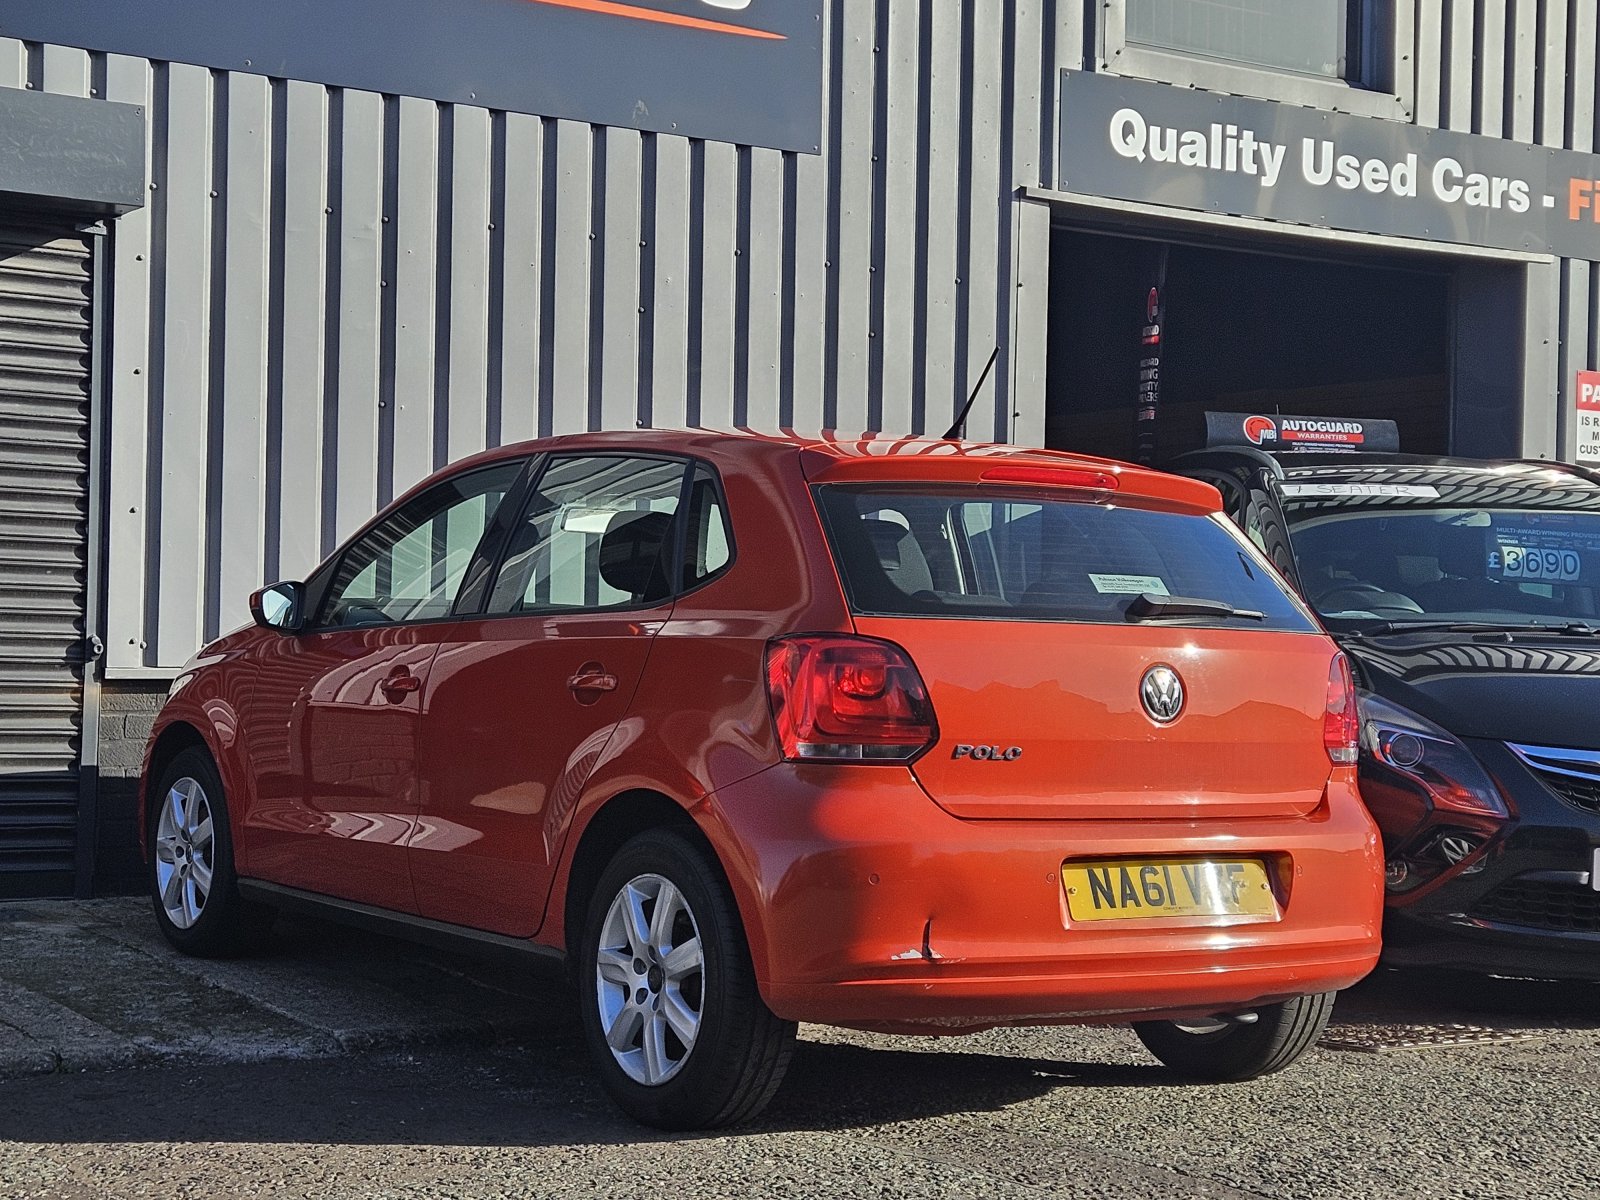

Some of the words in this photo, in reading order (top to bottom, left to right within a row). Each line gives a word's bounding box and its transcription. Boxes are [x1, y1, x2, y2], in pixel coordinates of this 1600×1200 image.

[1109, 108, 1286, 187] Quality
[1302, 138, 1417, 198] Used
[1432, 158, 1530, 213] Cars
[1281, 420, 1363, 434] AUTOGUARD
[1581, 416, 1590, 426] IS
[1297, 432, 1348, 441] WARRANTIES
[1316, 485, 1415, 496] SEATER
[952, 744, 1023, 761] POLO
[1087, 865, 1177, 910] NA61
